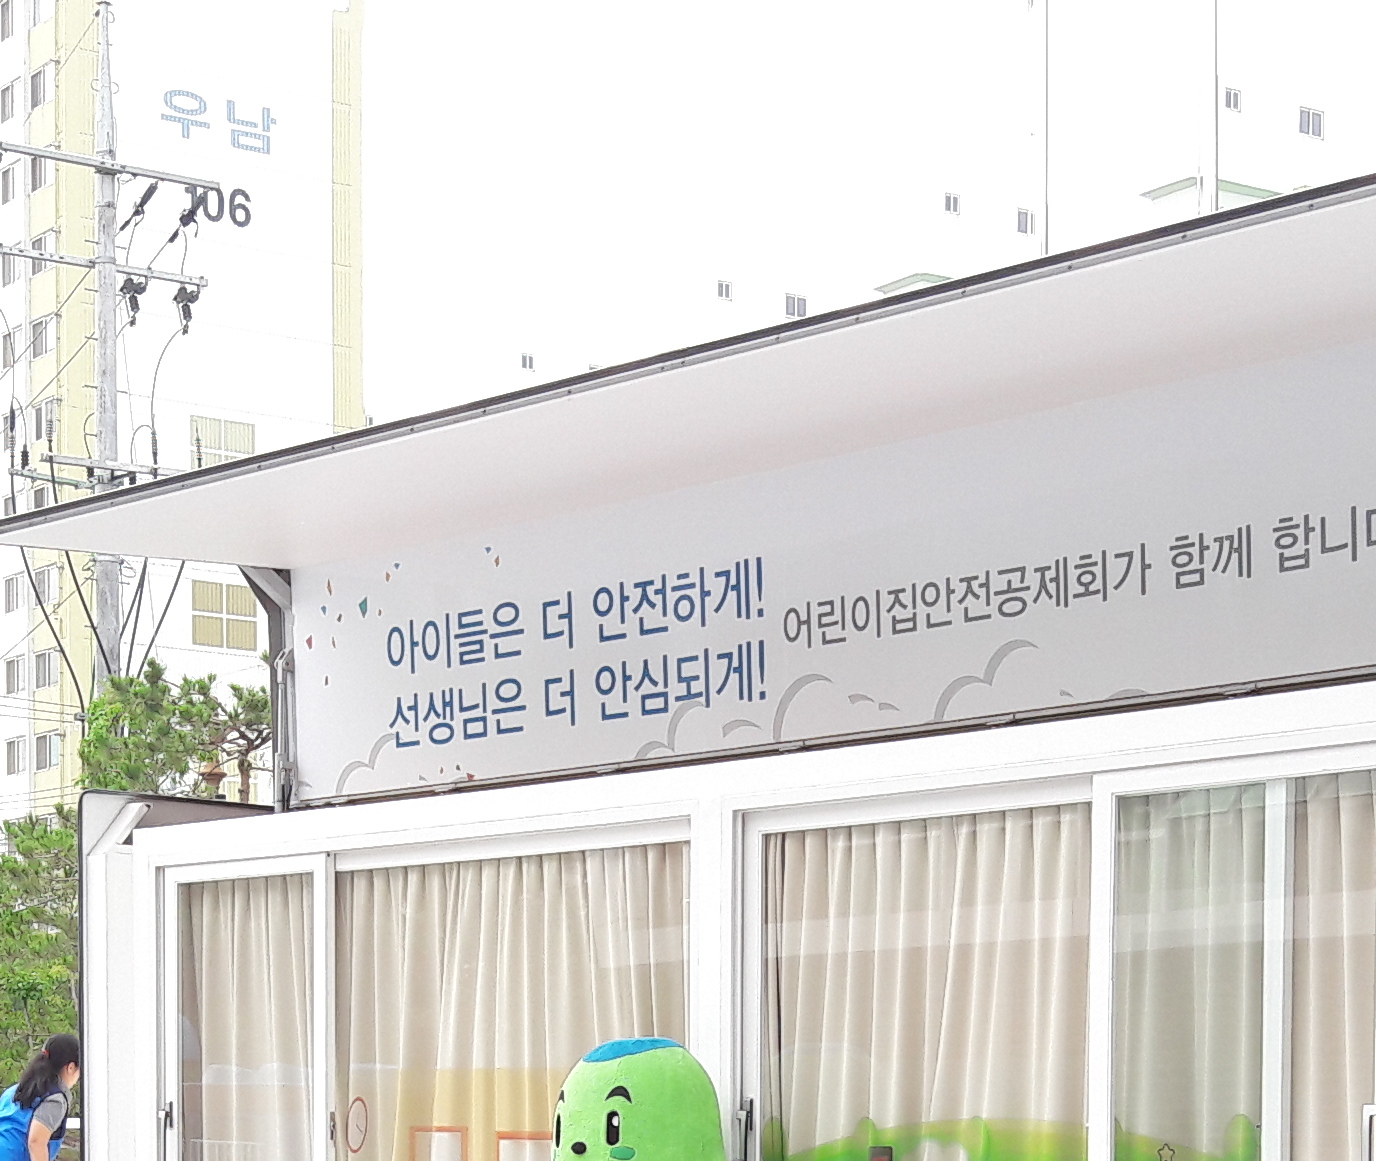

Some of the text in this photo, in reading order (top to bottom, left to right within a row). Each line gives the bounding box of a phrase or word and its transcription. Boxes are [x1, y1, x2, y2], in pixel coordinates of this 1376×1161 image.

[161, 89, 276, 155] 우남
[184, 185, 252, 228] 106
[386, 556, 766, 674] 아이들은 더 안전하게!
[782, 541, 1153, 649] 어린이집안전공제회가
[1169, 523, 1254, 590] 함께
[387, 640, 768, 748] 선생님은 더 안심되게!
